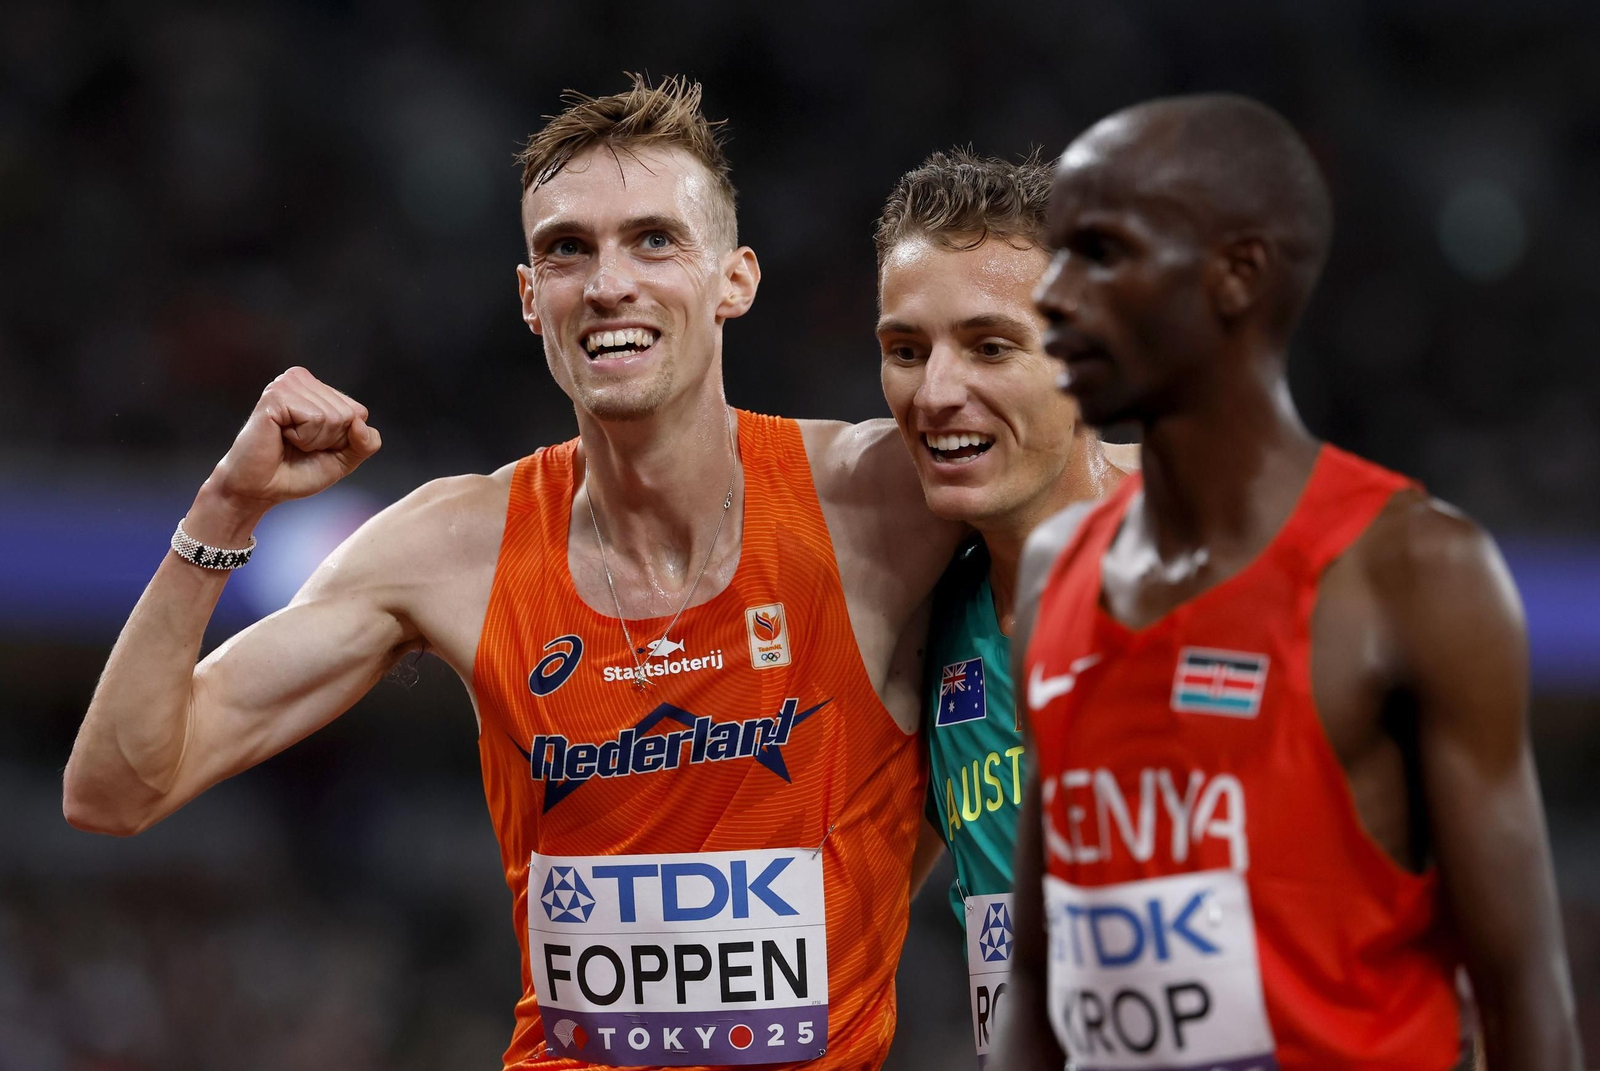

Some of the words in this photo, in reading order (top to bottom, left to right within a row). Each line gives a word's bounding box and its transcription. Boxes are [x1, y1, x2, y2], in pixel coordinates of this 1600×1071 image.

[603, 650, 724, 682] Staatsloterij
[531, 698, 799, 781] Nederland
[946, 746, 1026, 842] AUST
[592, 857, 800, 923] TDK
[543, 938, 808, 1006] FOPPEN
[766, 1021, 814, 1047] 25
